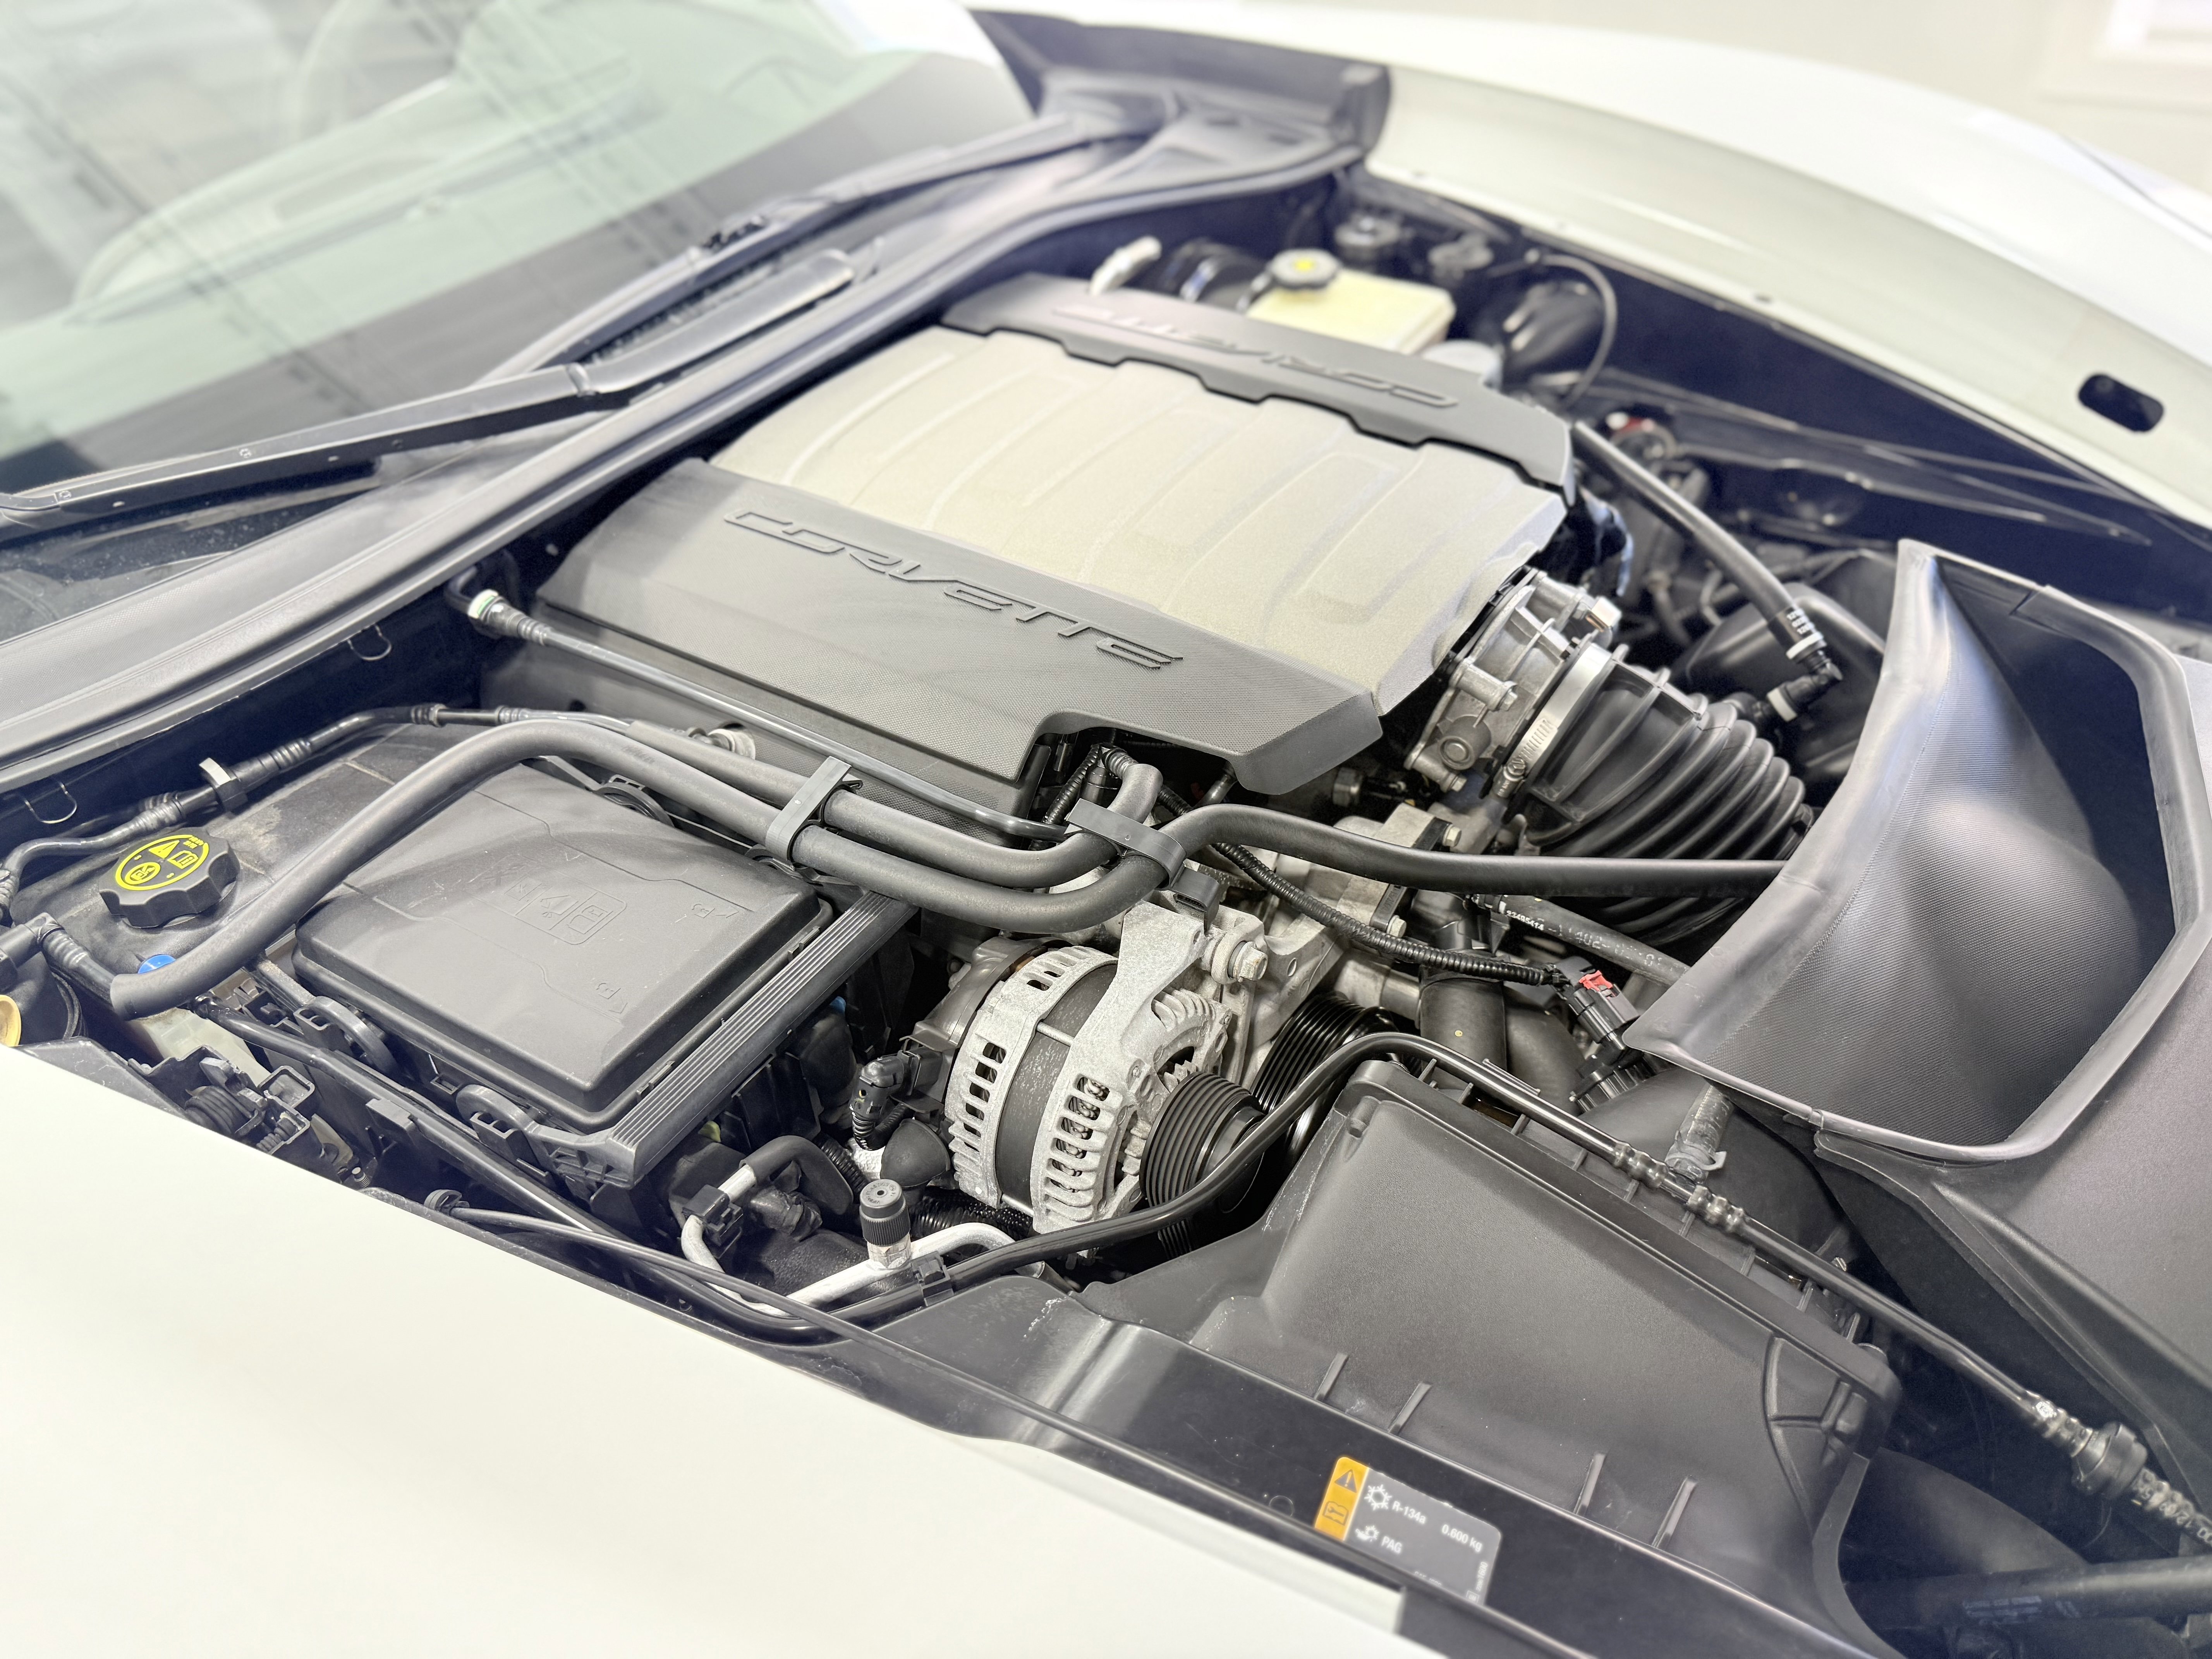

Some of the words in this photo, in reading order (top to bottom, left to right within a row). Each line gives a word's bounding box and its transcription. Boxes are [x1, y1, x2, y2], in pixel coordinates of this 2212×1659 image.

[724, 510, 1183, 669] CORVETTE
[1381, 1536, 1403, 1554] PAG
[1392, 1501, 1427, 1525] R-134a
[1441, 1524, 1469, 1544] 0.600
[1470, 1537, 1483, 1553] kg
